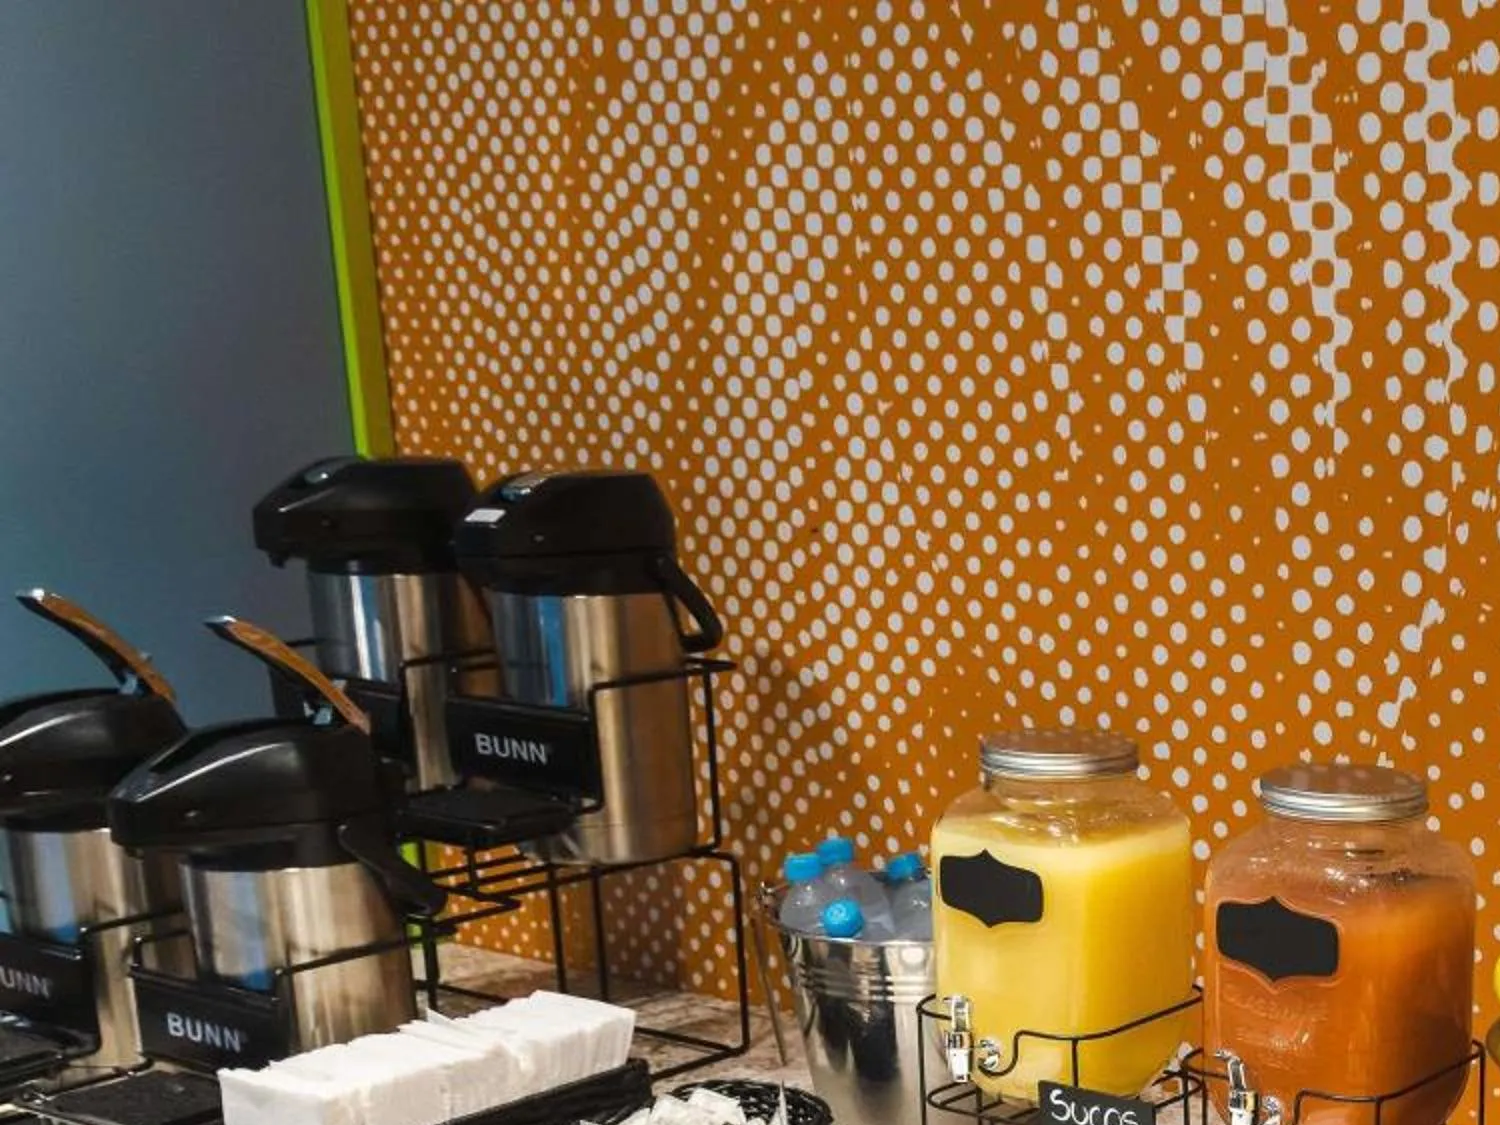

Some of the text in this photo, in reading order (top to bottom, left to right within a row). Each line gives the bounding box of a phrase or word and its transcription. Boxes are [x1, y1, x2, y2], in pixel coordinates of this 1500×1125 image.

[473, 732, 548, 766] BUNN
[0, 965, 50, 998] UNN
[166, 1011, 241, 1053] BUNN
